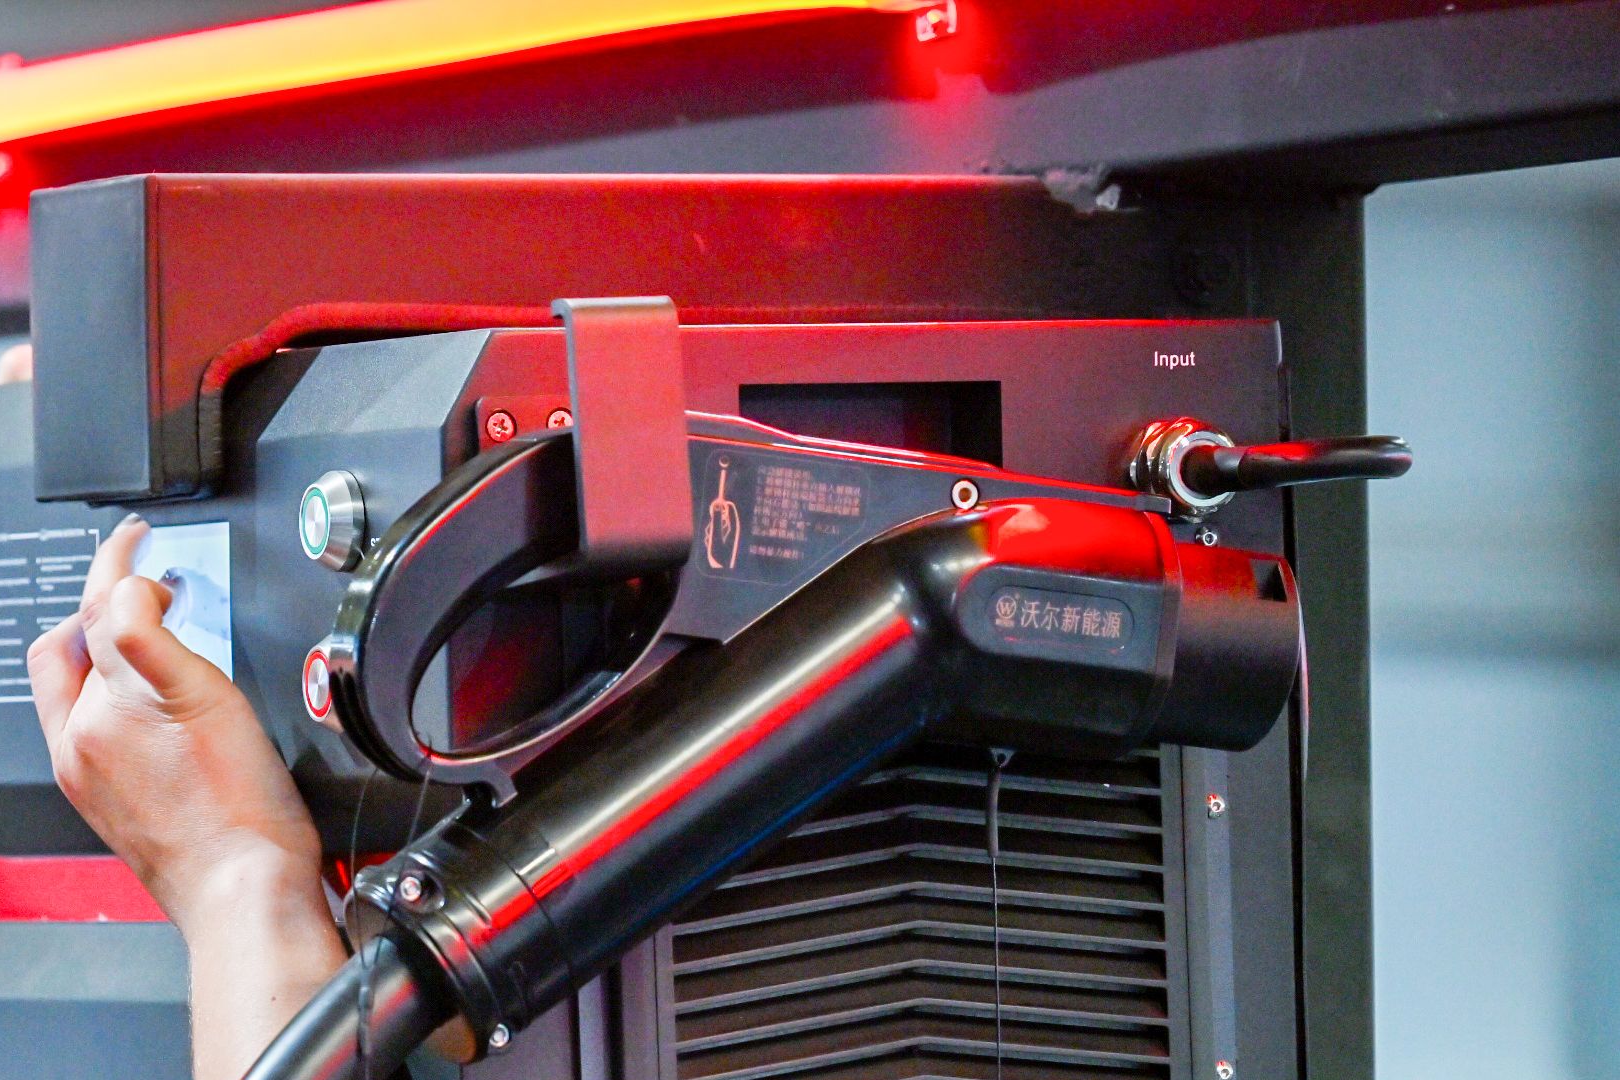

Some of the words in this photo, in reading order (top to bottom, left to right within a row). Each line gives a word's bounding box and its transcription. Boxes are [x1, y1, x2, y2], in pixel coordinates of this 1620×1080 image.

[1154, 351, 1196, 370] Input
[1020, 599, 1123, 638] 沃尔新能源
